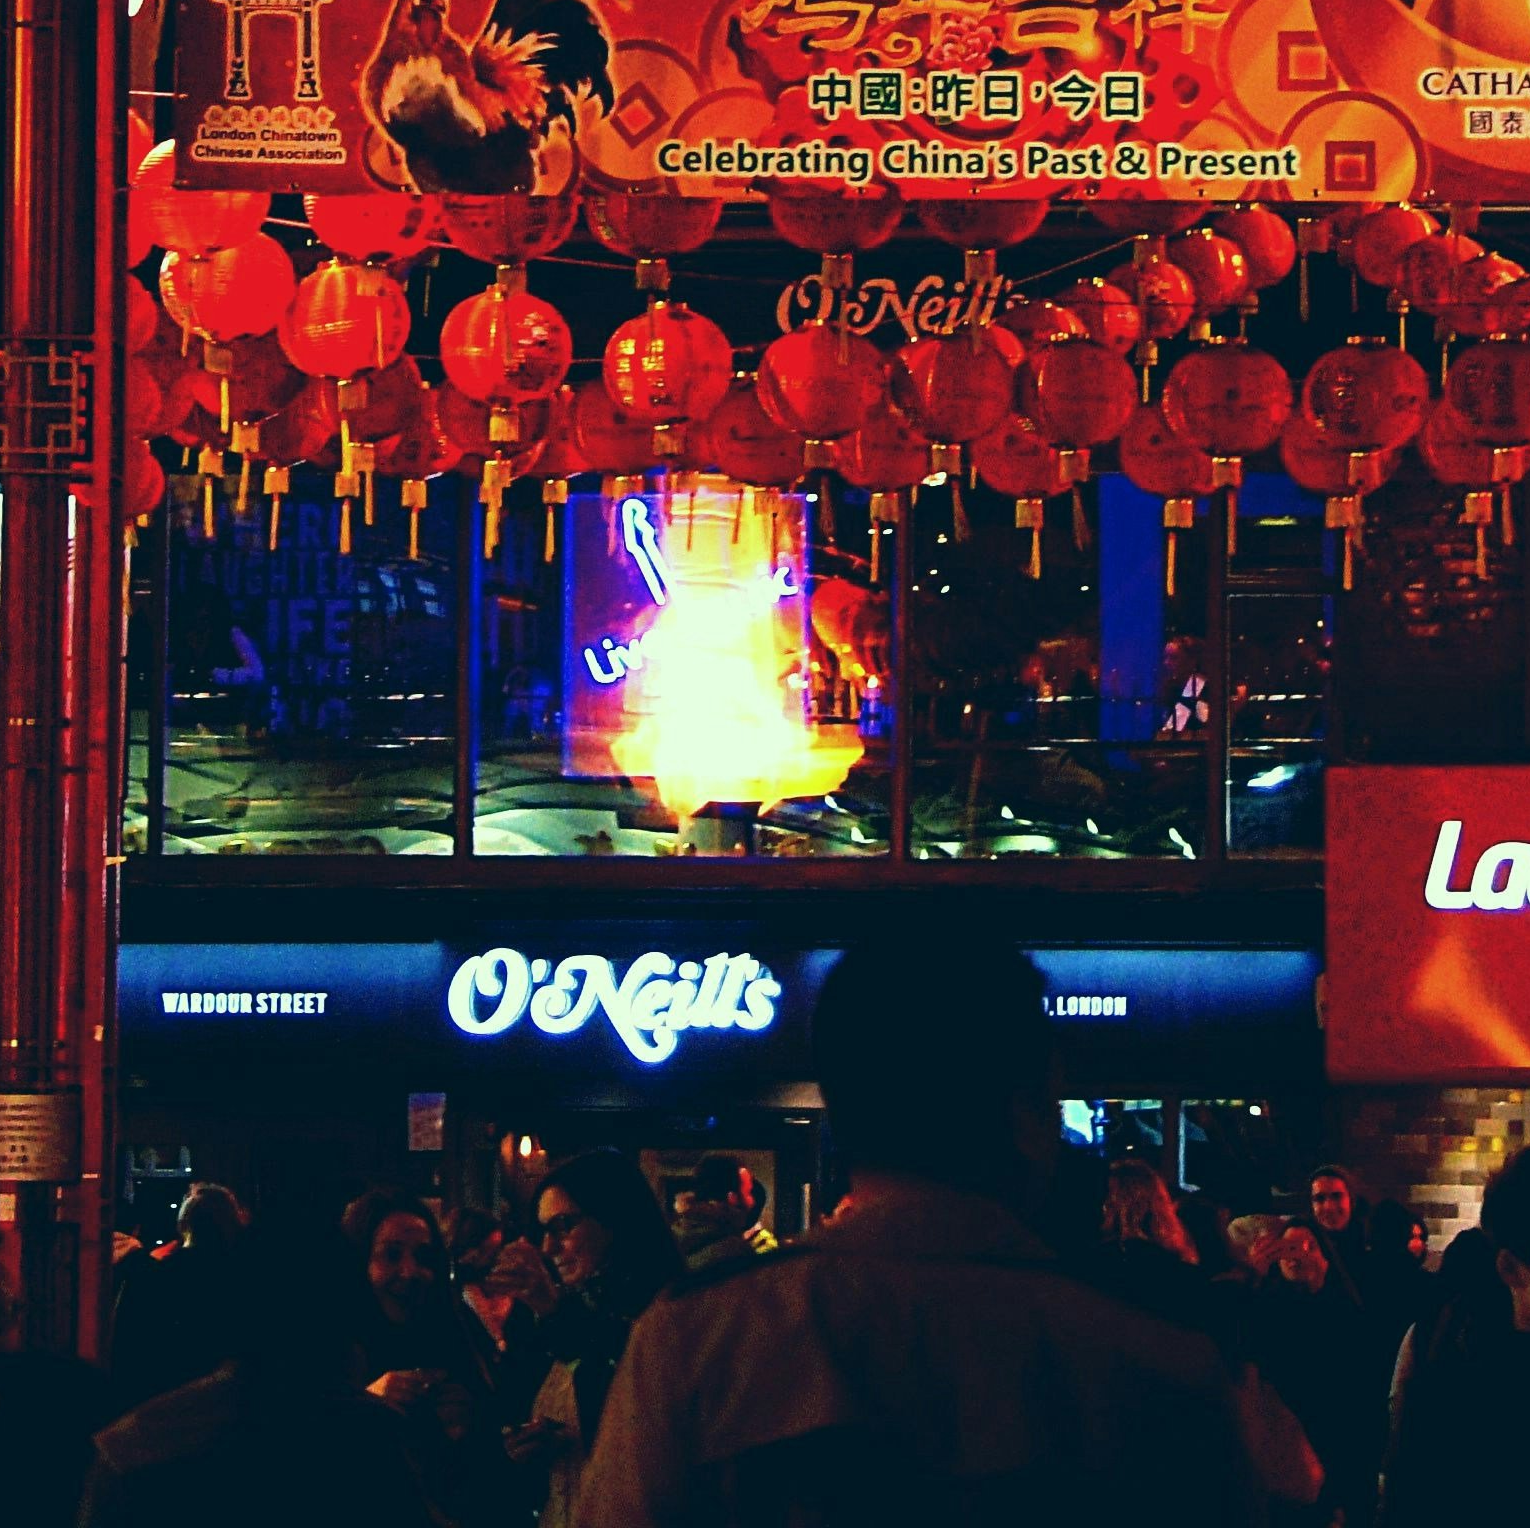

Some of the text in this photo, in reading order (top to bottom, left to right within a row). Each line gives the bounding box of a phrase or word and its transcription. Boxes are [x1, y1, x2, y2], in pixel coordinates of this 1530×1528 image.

[201, 127, 337, 142] London Chinatown
[194, 144, 343, 160] Chinese Association
[659, 144, 1297, 180] Celebrating China's Past & Present
[162, 992, 328, 1014] WARDOUR STREET
[447, 947, 782, 1064] O'Neill's
